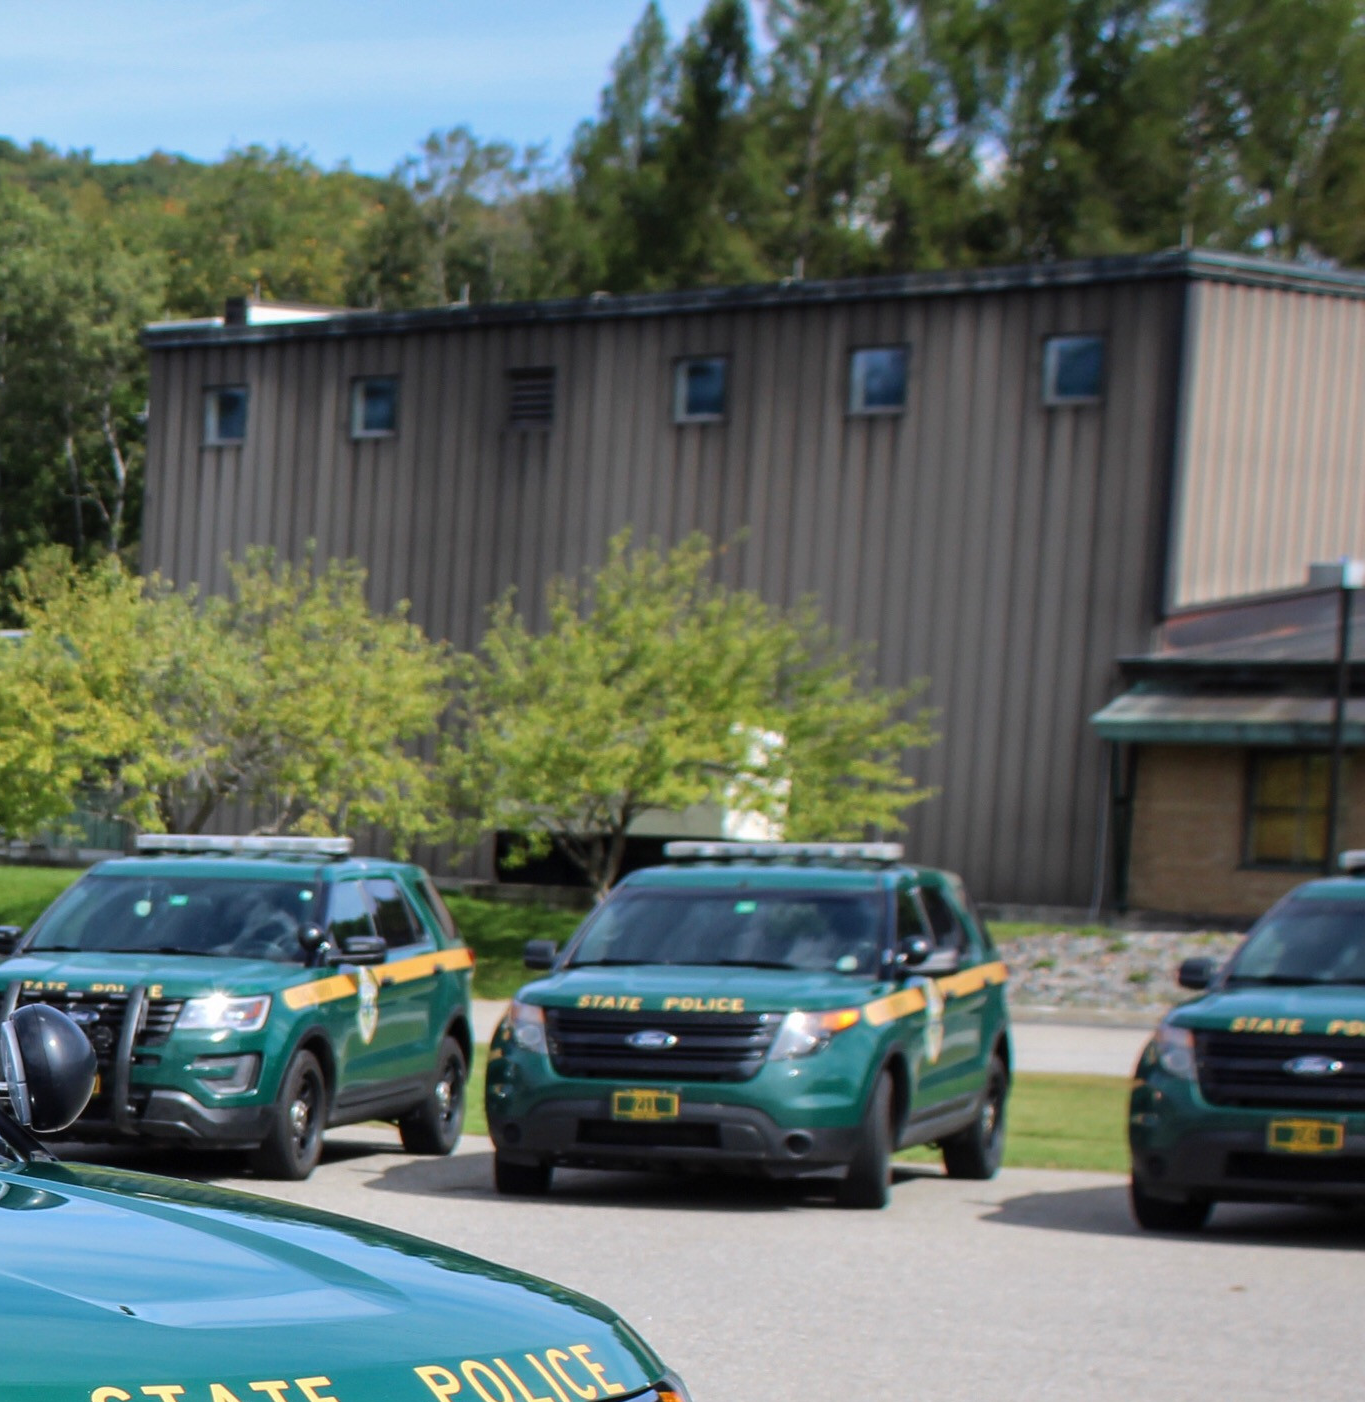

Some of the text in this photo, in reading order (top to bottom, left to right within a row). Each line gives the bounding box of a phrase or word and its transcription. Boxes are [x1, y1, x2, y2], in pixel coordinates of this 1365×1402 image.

[22, 980, 68, 991] TATE
[577, 994, 746, 1013] STATE POLICE
[1230, 1016, 1365, 1036] STATE PO
